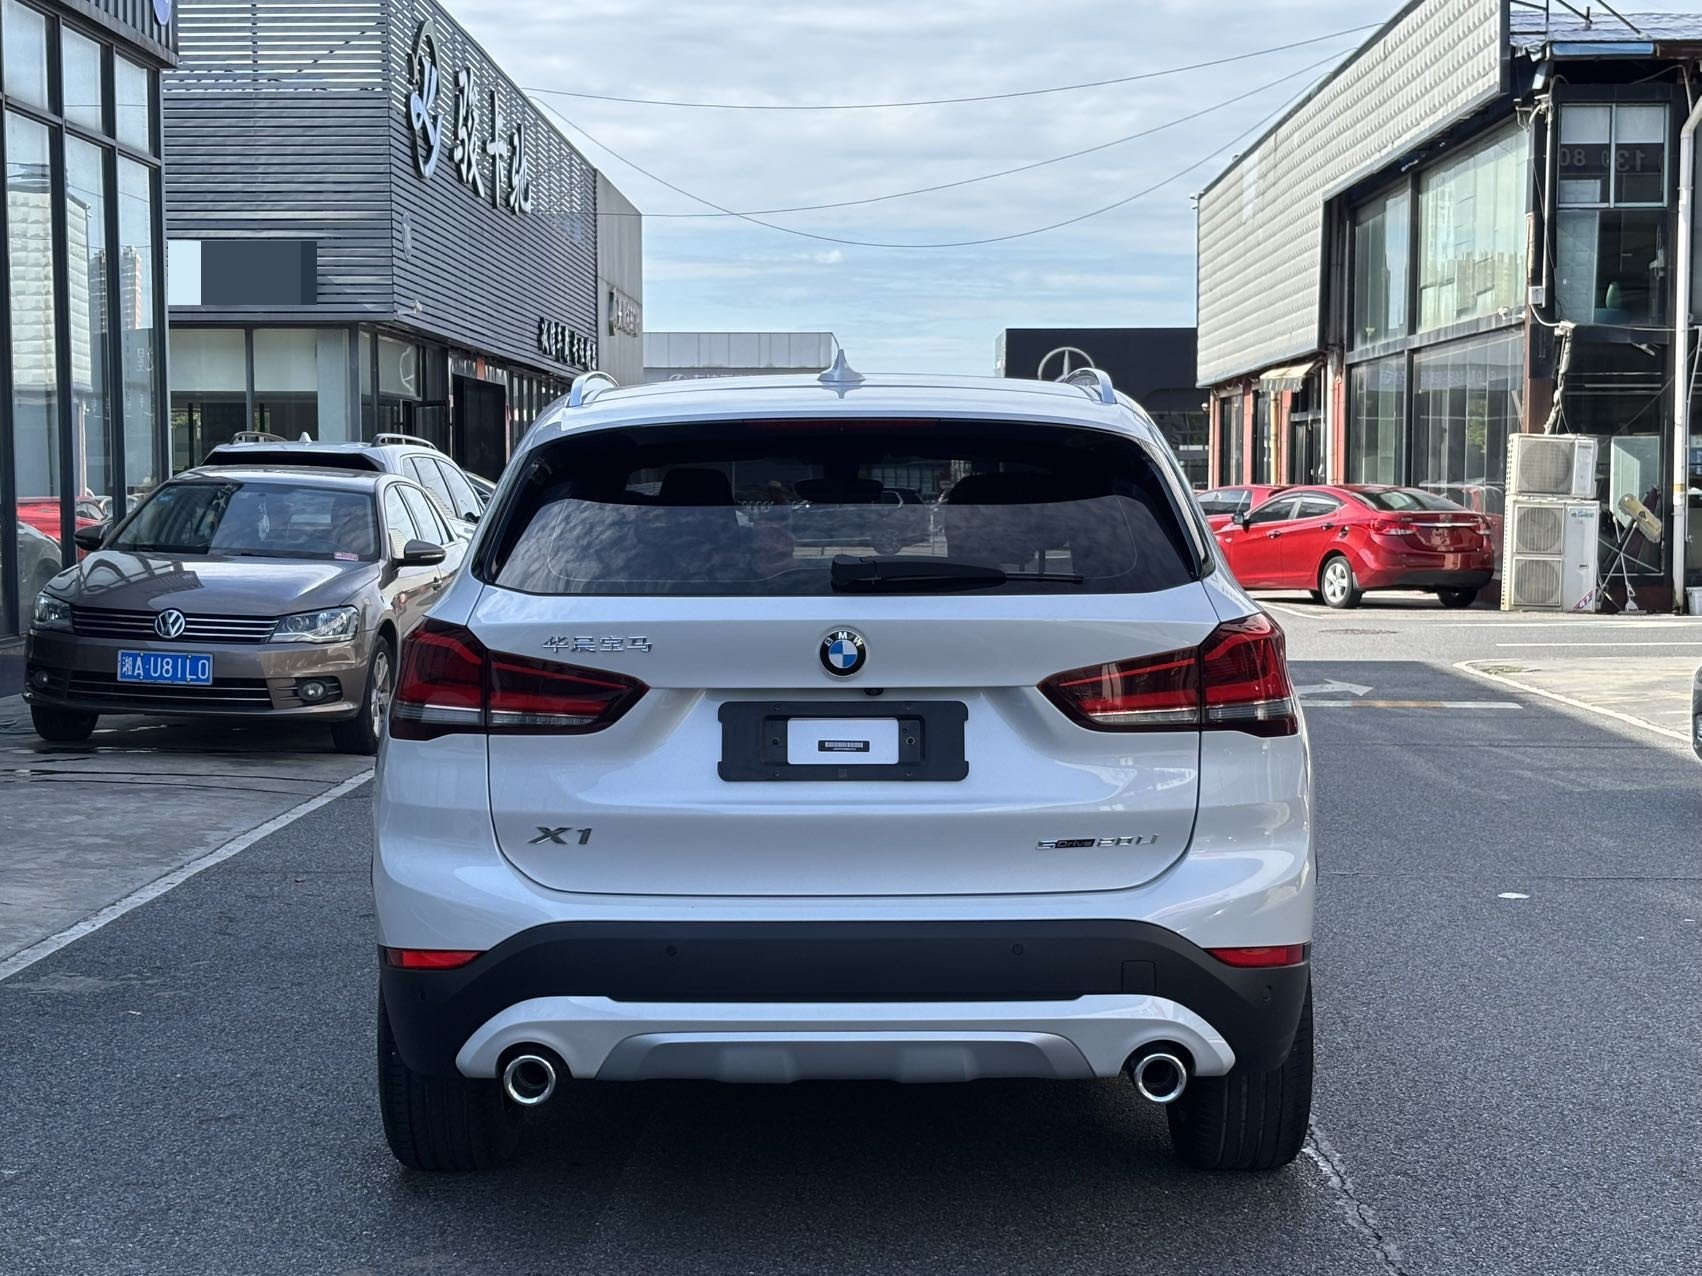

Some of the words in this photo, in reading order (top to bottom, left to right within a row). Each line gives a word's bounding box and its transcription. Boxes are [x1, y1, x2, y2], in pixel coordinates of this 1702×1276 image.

[542, 635, 653, 653] 华晨宝马
[528, 826, 592, 845] X1
